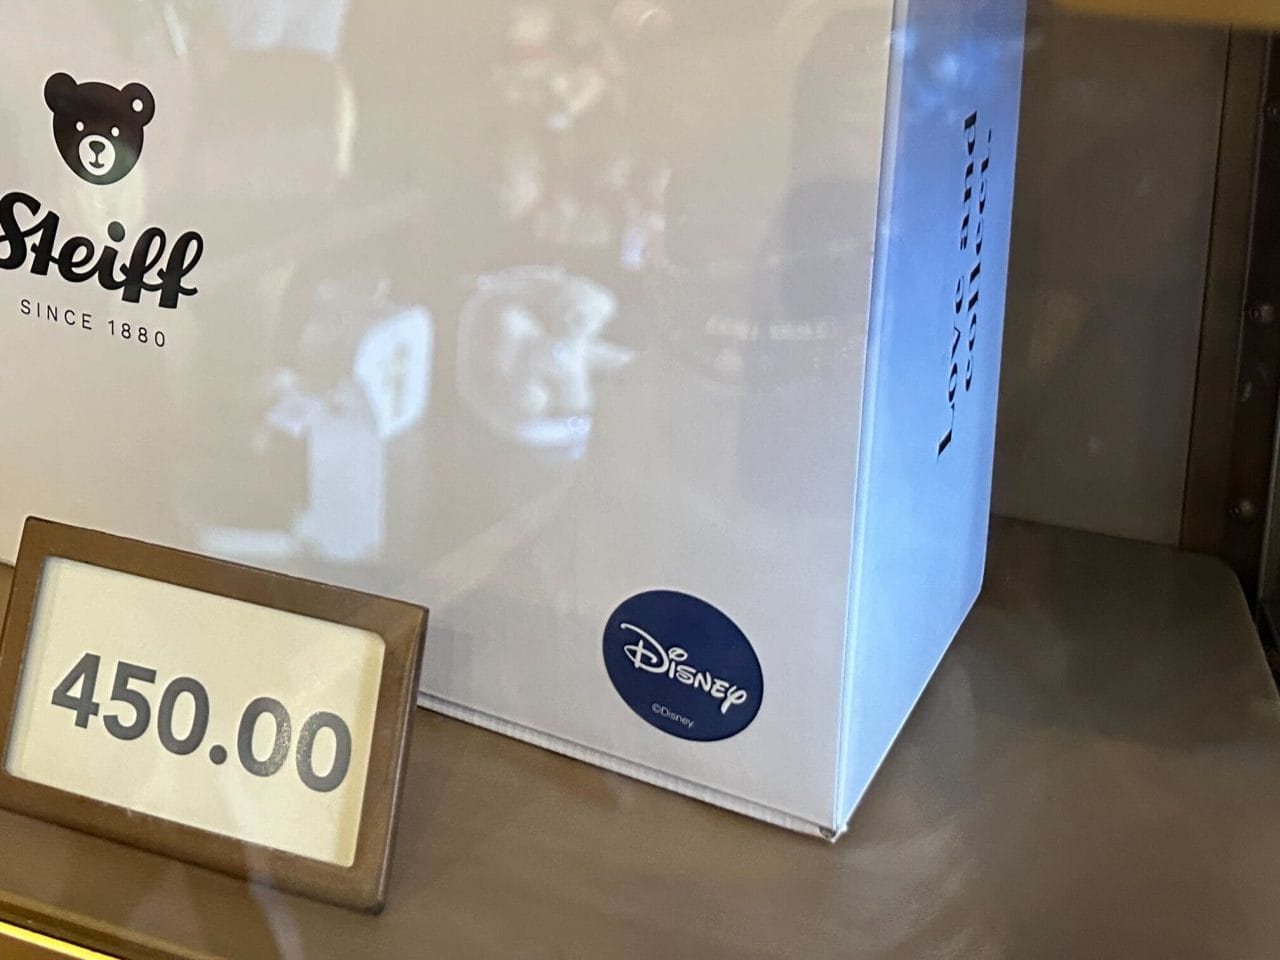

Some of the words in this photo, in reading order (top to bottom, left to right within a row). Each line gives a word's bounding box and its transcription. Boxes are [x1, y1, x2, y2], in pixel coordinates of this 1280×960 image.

[20, 299, 93, 330] SINCE
[108, 319, 166, 348] 1880
[936, 274, 966, 463] Love
[959, 110, 978, 252] and
[51, 652, 353, 794] 450.00
